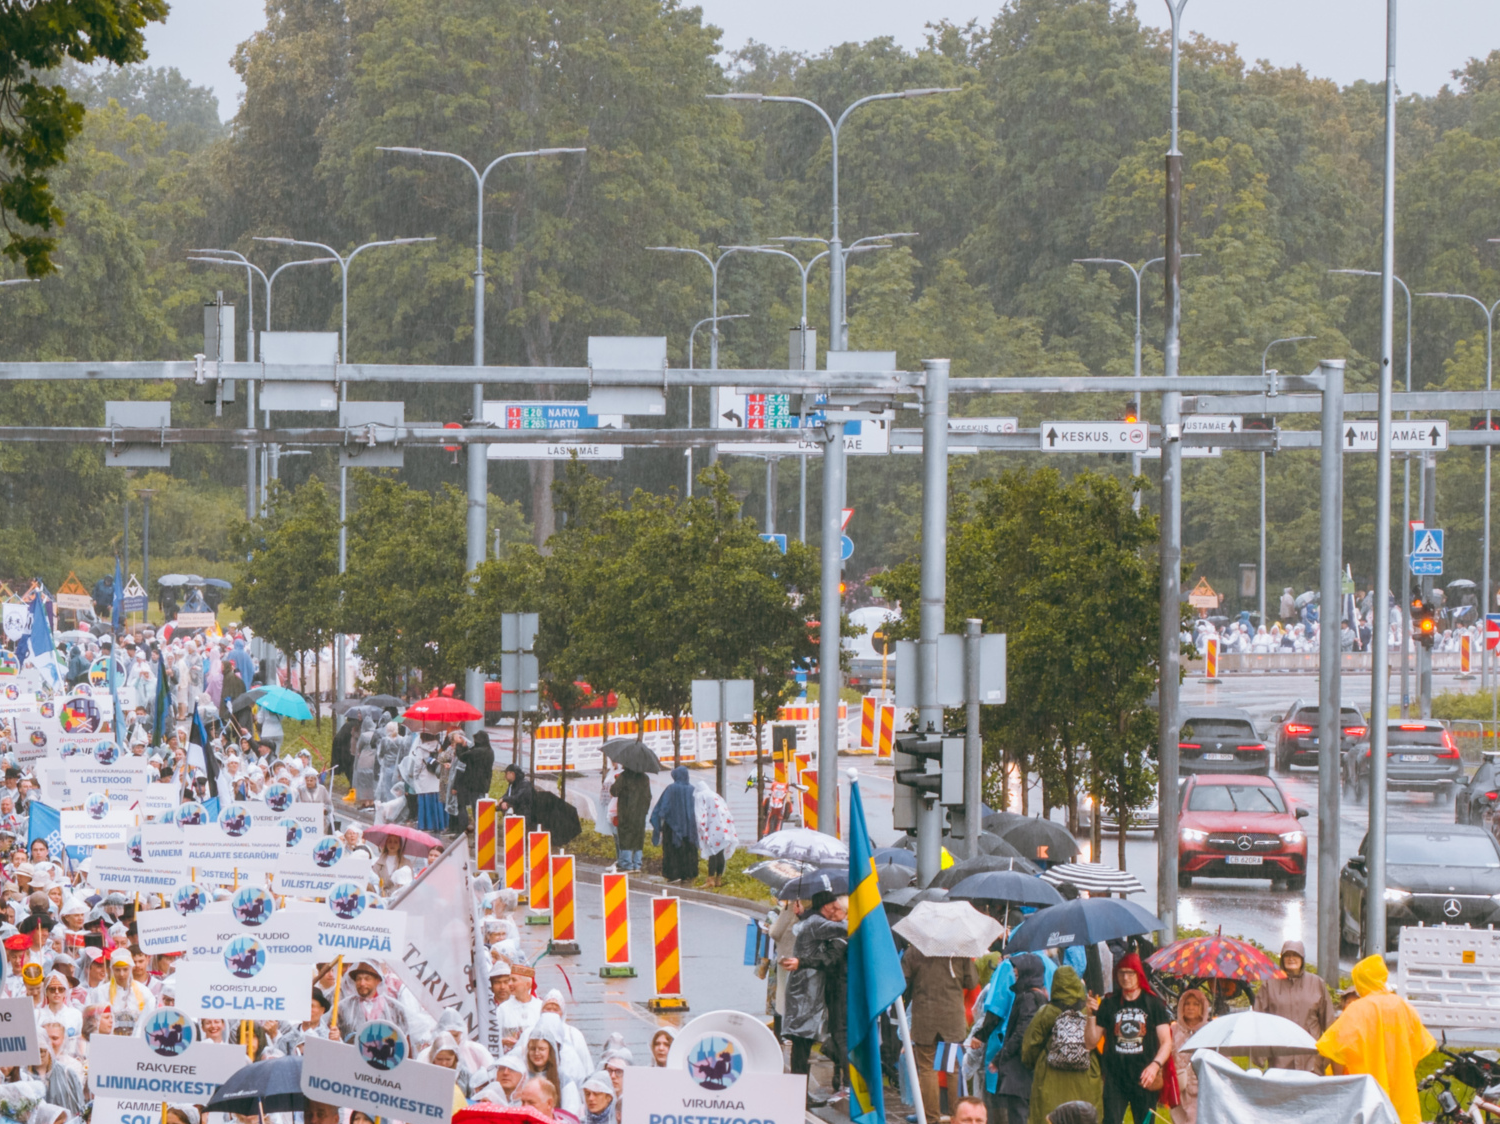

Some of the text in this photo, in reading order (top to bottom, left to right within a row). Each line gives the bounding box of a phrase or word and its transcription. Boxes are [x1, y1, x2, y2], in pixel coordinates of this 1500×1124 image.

[512, 408, 518, 418] 1
[531, 408, 543, 418] 20
[548, 408, 580, 418] NARVA
[753, 405, 790, 415] 2 E 26
[511, 420, 518, 429] 2
[531, 420, 546, 429] 263
[548, 420, 579, 429] TARTU
[752, 418, 761, 428] 4
[768, 419, 774, 428] E
[1186, 420, 1227, 431] USTAMÄE
[1061, 430, 1128, 442] KESKUS, C
[1360, 427, 1426, 441] MUAMÄE
[547, 444, 600, 456] LASNMÄE
[80, 776, 132, 784] LASTEKOOR
[74, 832, 121, 840] POISTEKOOR
[147, 848, 183, 858] VANEM
[188, 851, 231, 860] ALGAJATE
[99, 872, 177, 887] TARVA TAMMED
[201, 869, 249, 881] OISTEKOOR
[281, 878, 335, 891] VILISTLAS
[318, 921, 392, 935] ATANTSUANSAMBEL
[144, 935, 179, 947] VANEM
[318, 932, 392, 953] RVANPÄÄ
[209, 984, 278, 993] KOORISTUUDIO
[200, 995, 286, 1011] SO-LA-RE
[136, 1062, 197, 1076] RAKVERE
[96, 1075, 221, 1096] LINNAORKEST
[353, 1071, 403, 1091] VIRUMAA
[307, 1075, 445, 1119] NOORTEORKESTER
[682, 1098, 746, 1111] VIRUMAA
